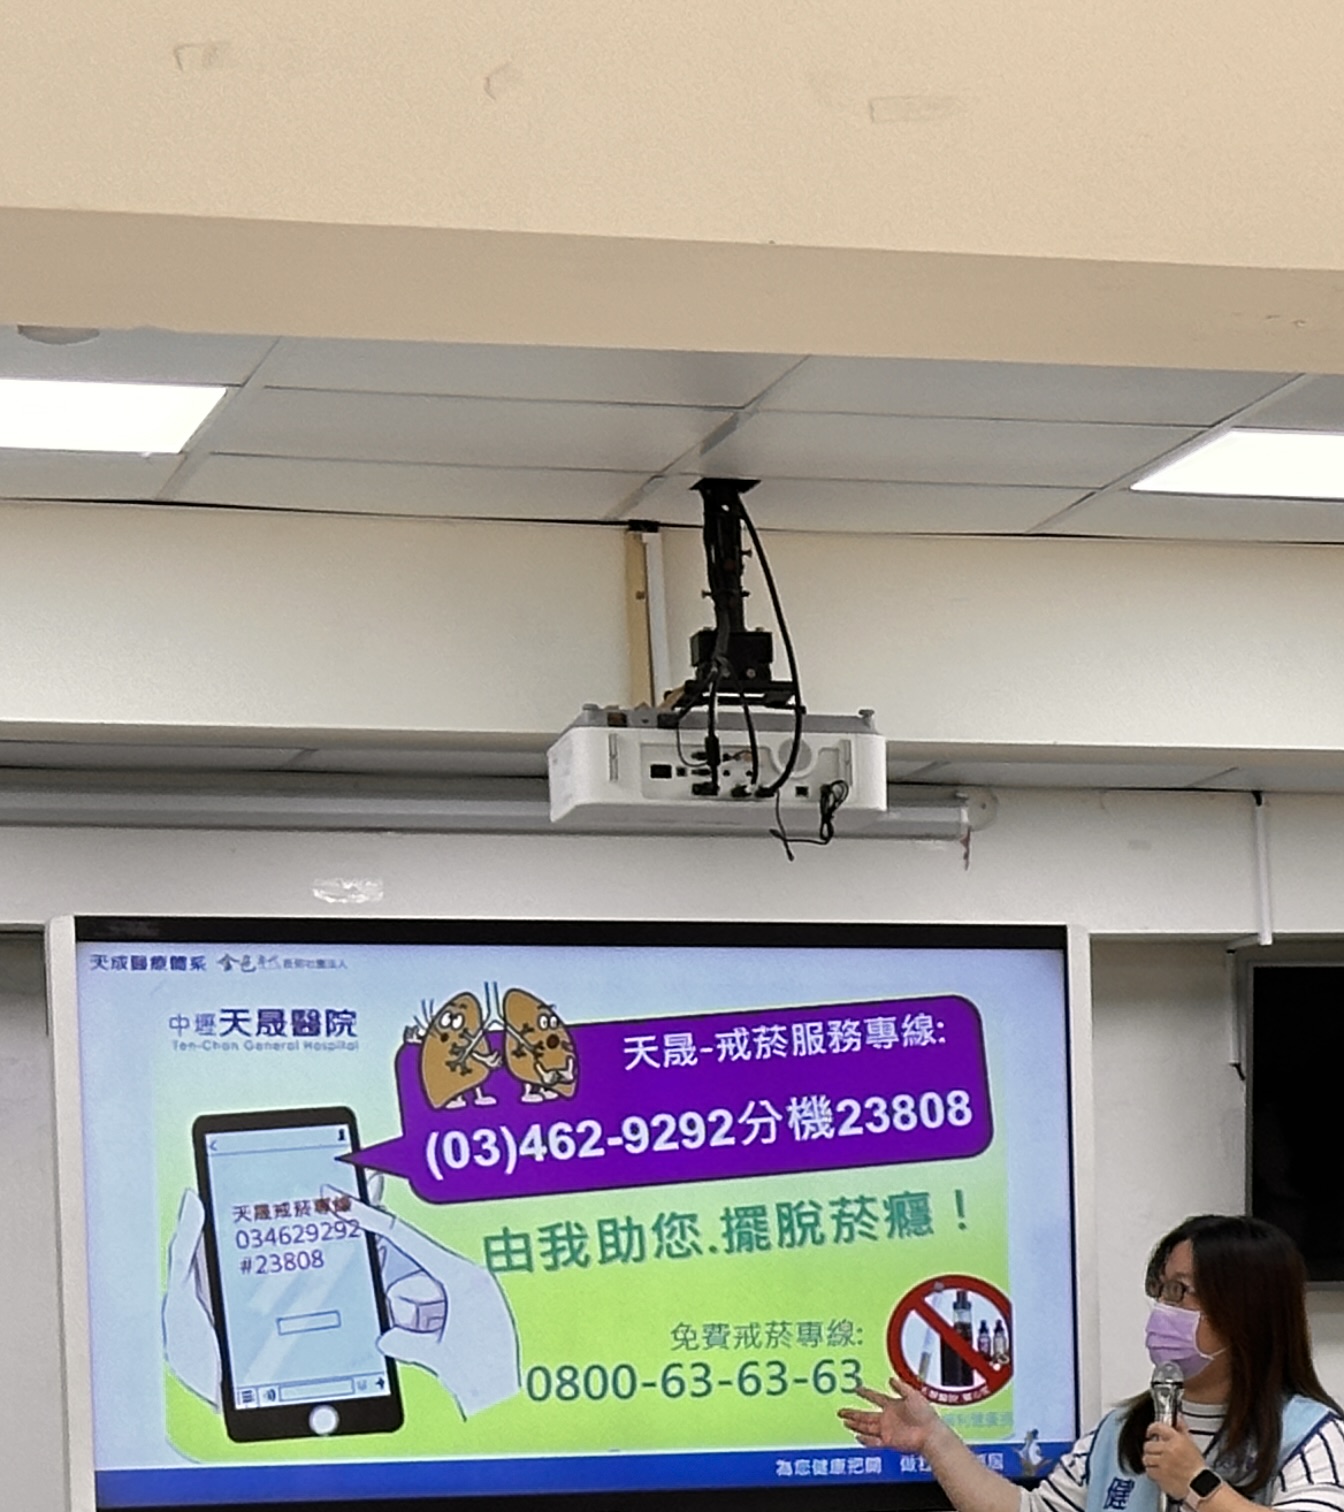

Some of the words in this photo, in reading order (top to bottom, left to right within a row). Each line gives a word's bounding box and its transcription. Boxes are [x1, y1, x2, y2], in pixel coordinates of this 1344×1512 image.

[244, 1040, 300, 1051] General
[303, 1040, 359, 1053] Hospital
[426, 1090, 973, 1180] (03)462-9292分機23808
[235, 1219, 361, 1249] 034629292
[240, 1249, 325, 1274] #23808
[670, 1318, 863, 1351] 免費戒菸專線:
[526, 1358, 864, 1402] 0800-63-63-63
